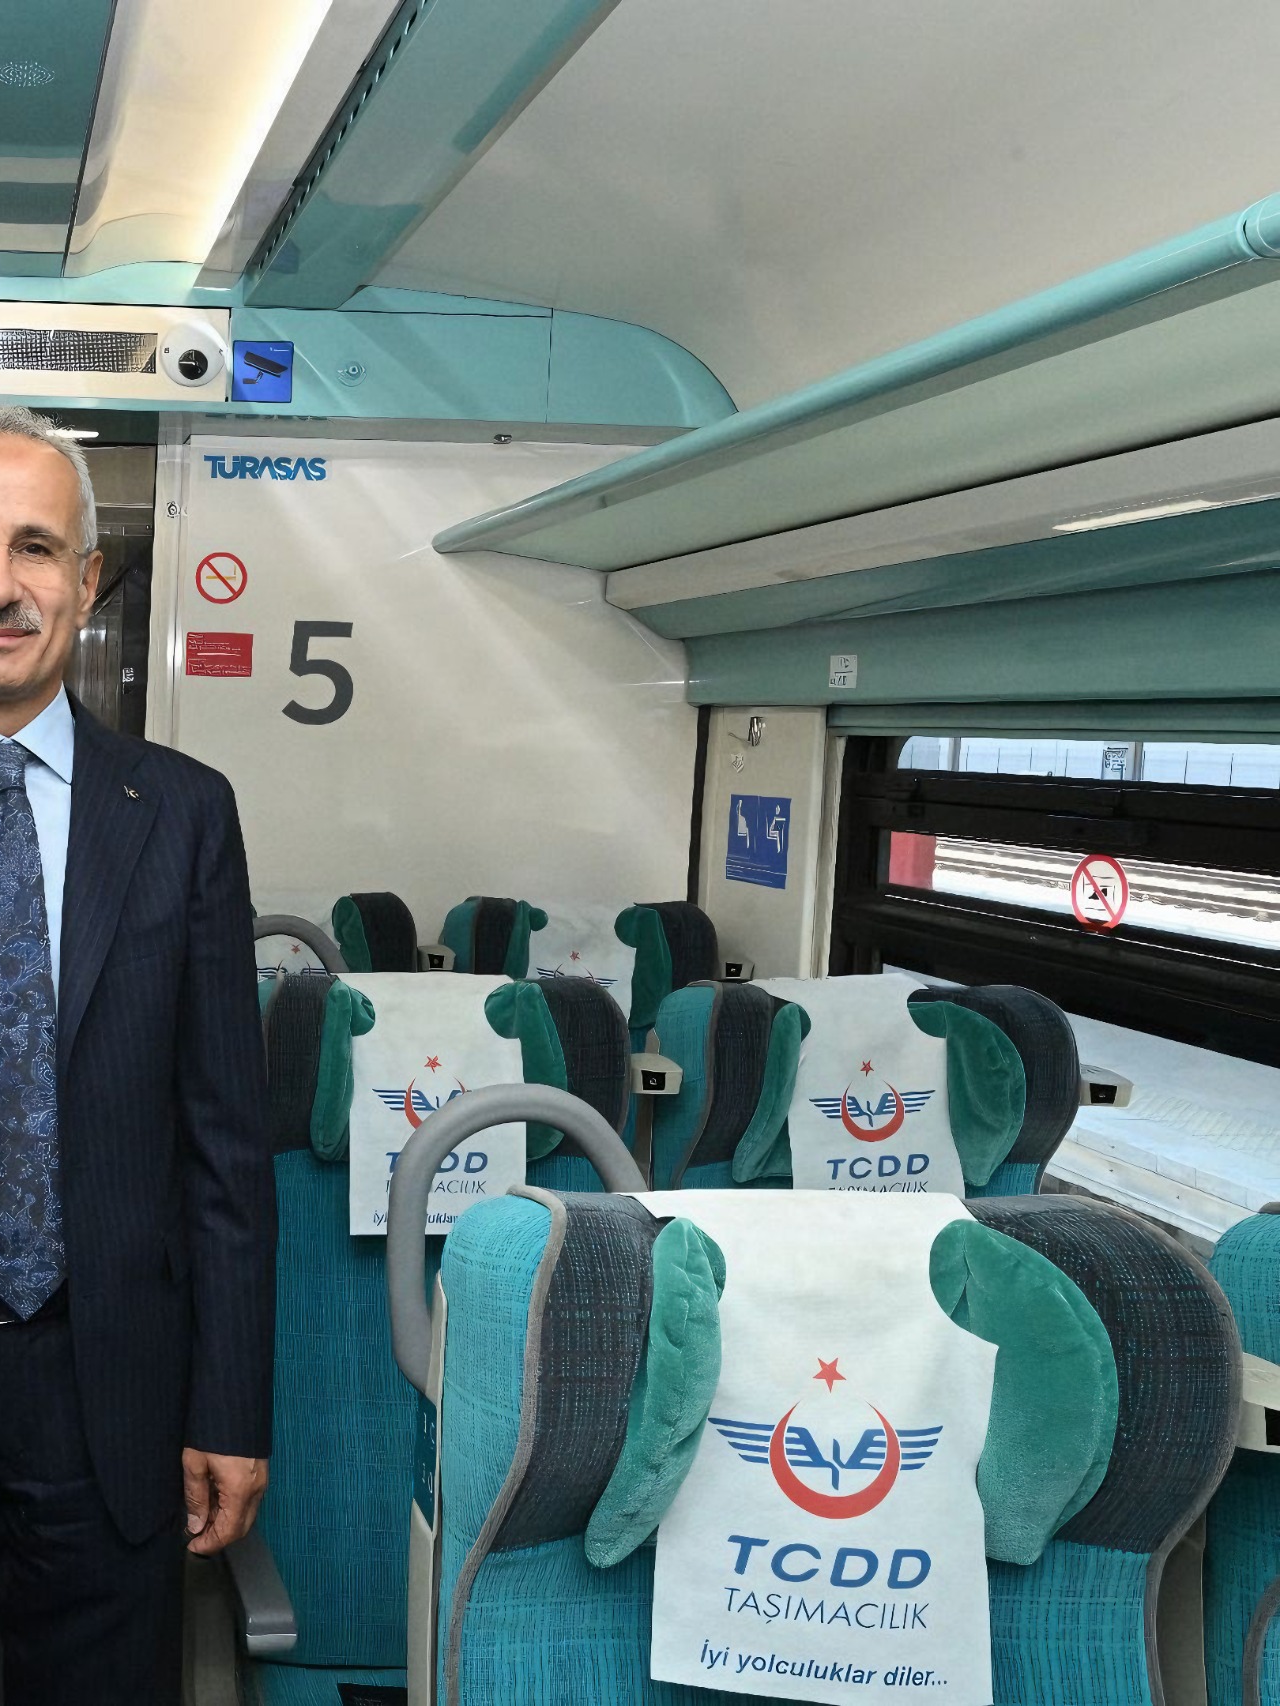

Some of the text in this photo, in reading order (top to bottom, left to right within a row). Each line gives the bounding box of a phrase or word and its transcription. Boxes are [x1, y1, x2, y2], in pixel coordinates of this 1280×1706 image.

[282, 620, 353, 725] 5
[386, 1152, 488, 1174] TDD
[826, 1153, 930, 1180] TCDD
[727, 1535, 932, 1590] TCDD
[724, 1586, 930, 1630] TAŞIMACILIK
[700, 1638, 948, 1687] İyi yolculuklar diler...
